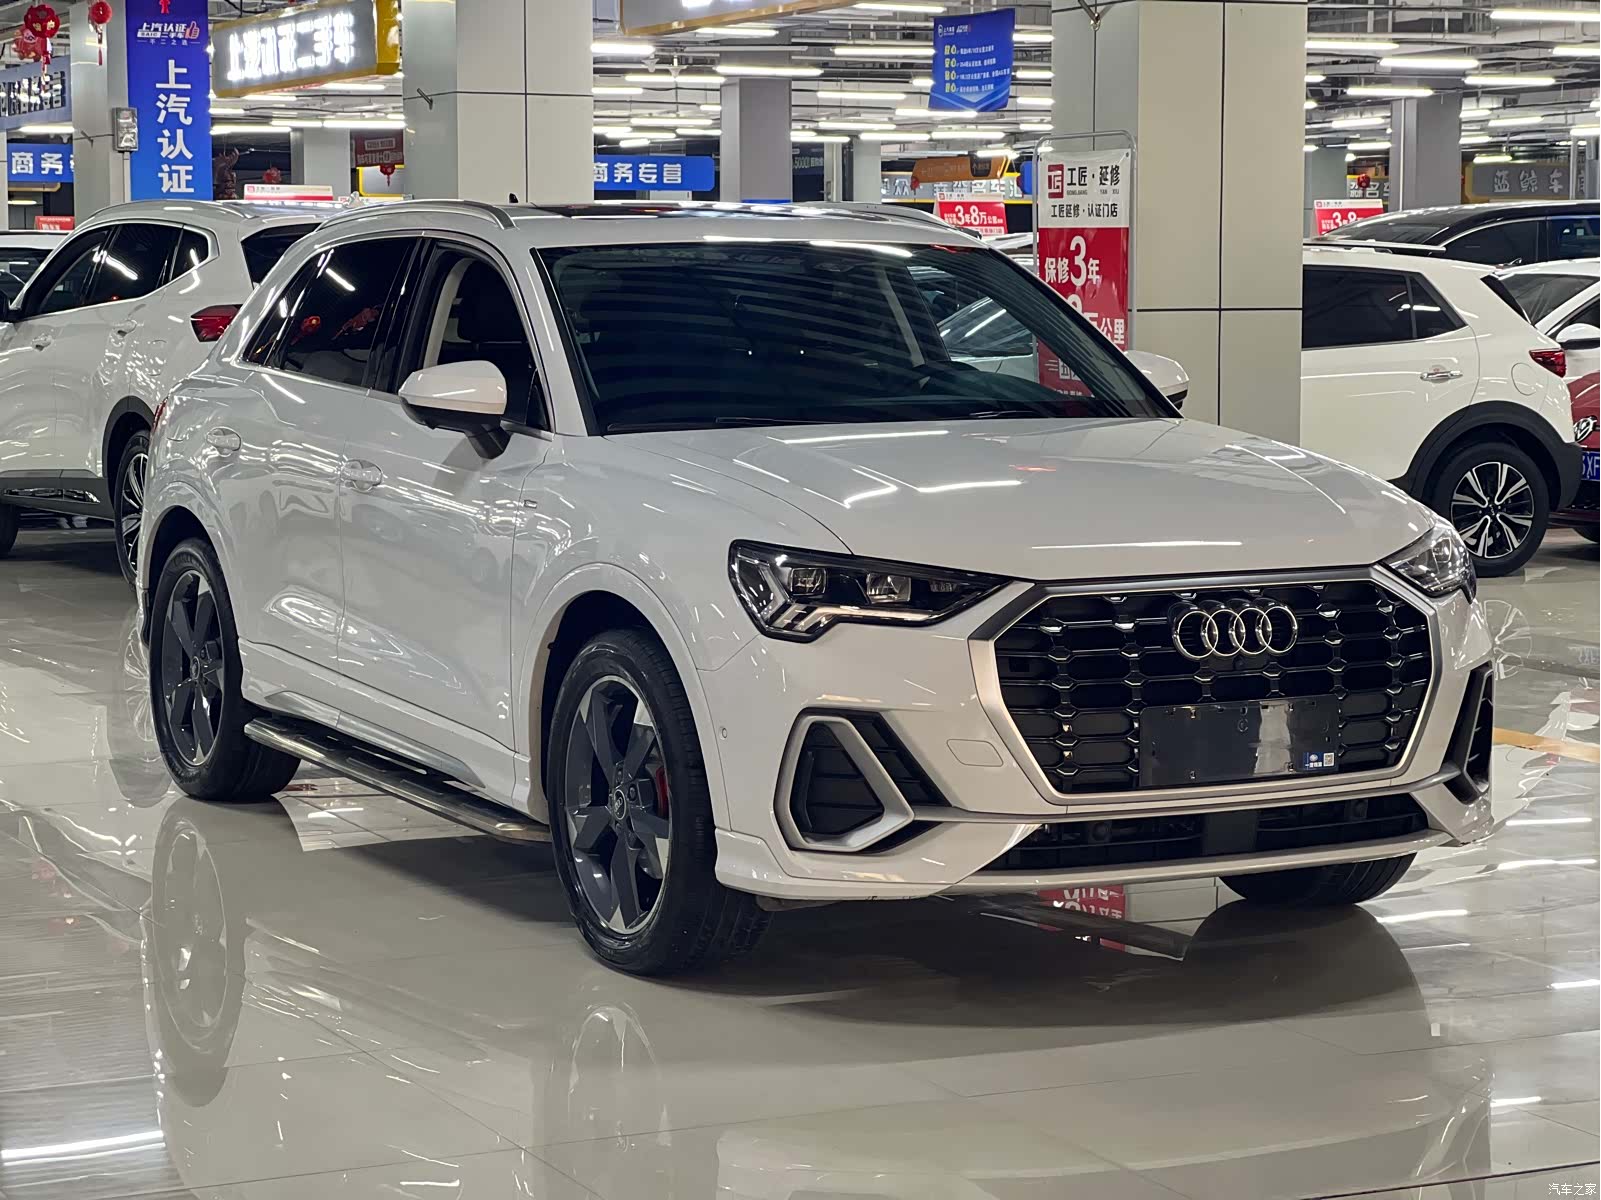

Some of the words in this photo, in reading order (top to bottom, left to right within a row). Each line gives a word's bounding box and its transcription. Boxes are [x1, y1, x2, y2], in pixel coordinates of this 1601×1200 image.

[142, 22, 187, 32] 上汽认证
[155, 59, 195, 193] 上汽认证
[594, 162, 682, 184] 商务专营
[1051, 203, 1118, 218] 工匠延修·认证门店
[1045, 235, 1100, 287] 保修3年
